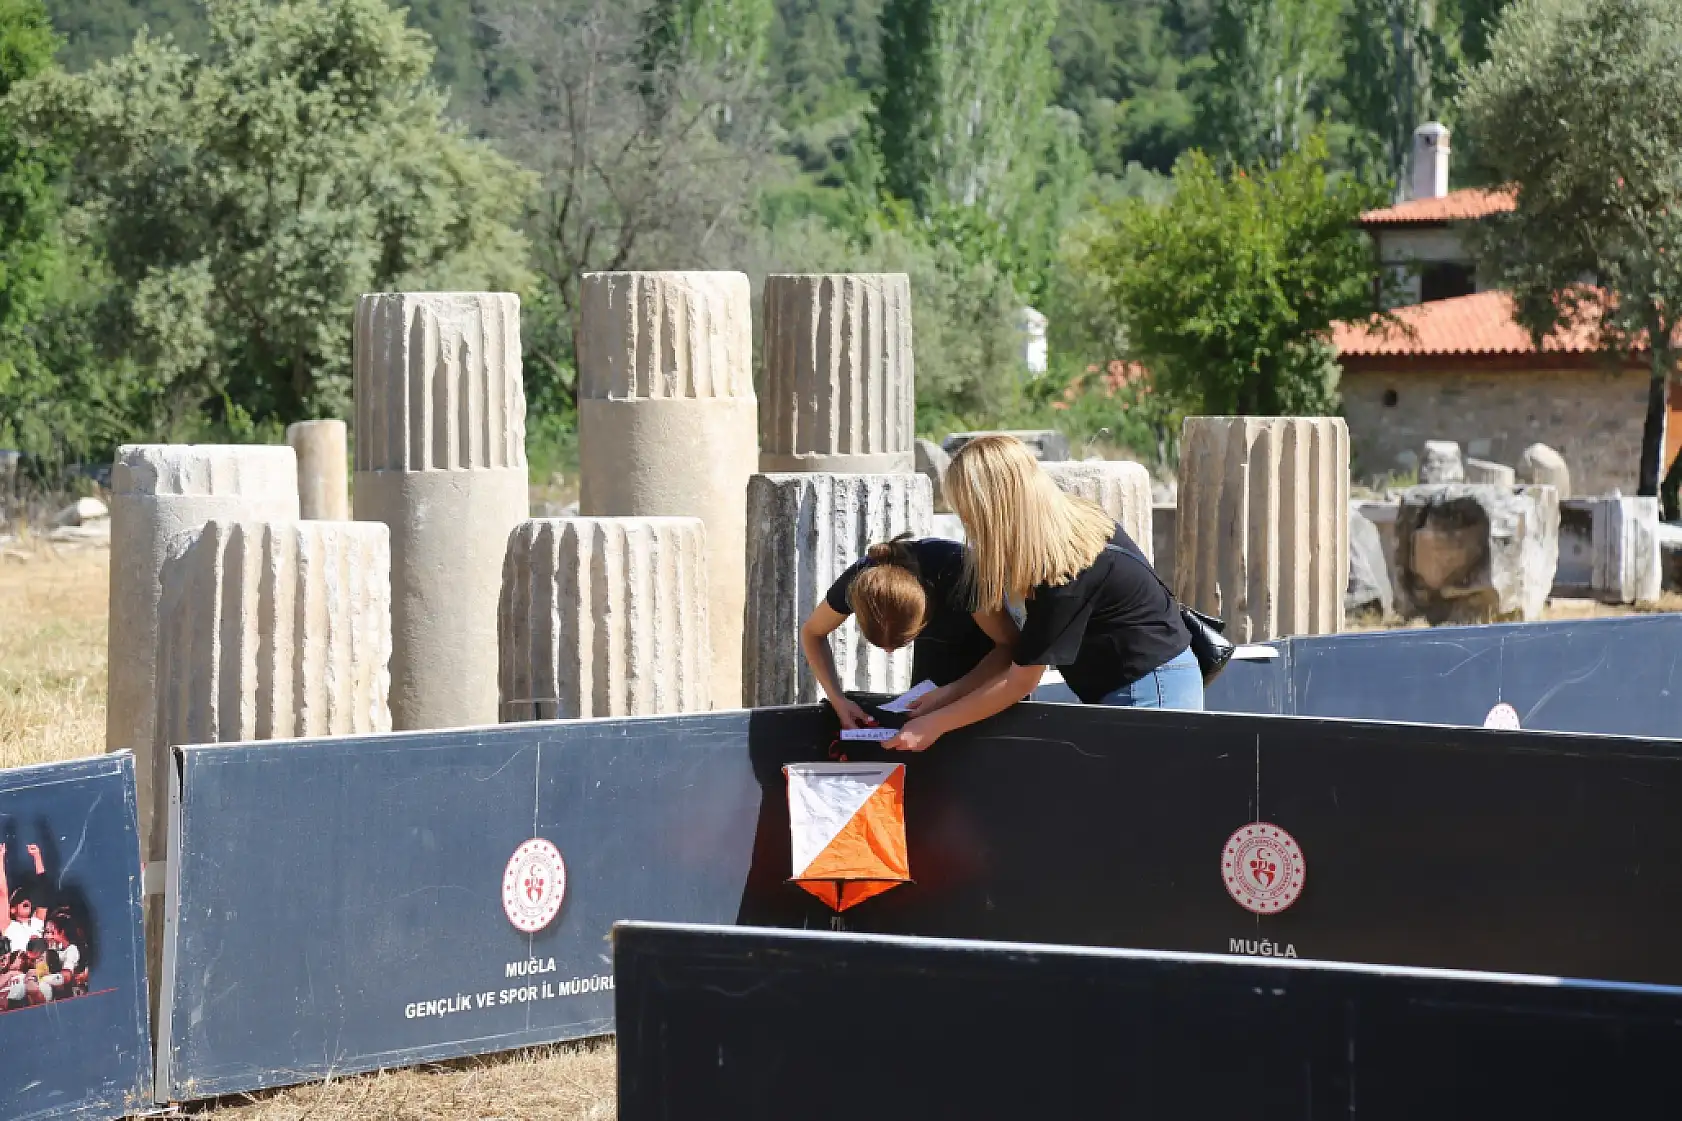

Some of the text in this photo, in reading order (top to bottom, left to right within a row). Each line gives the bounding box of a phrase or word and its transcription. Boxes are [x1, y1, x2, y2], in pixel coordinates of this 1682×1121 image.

[1228, 937, 1298, 958] MUĞLA
[504, 956, 556, 977] MUĞLA
[405, 993, 471, 1018] GENÇLİK
[476, 991, 495, 1008] VE
[499, 986, 538, 1005] SPOR
[542, 980, 554, 999] İL
